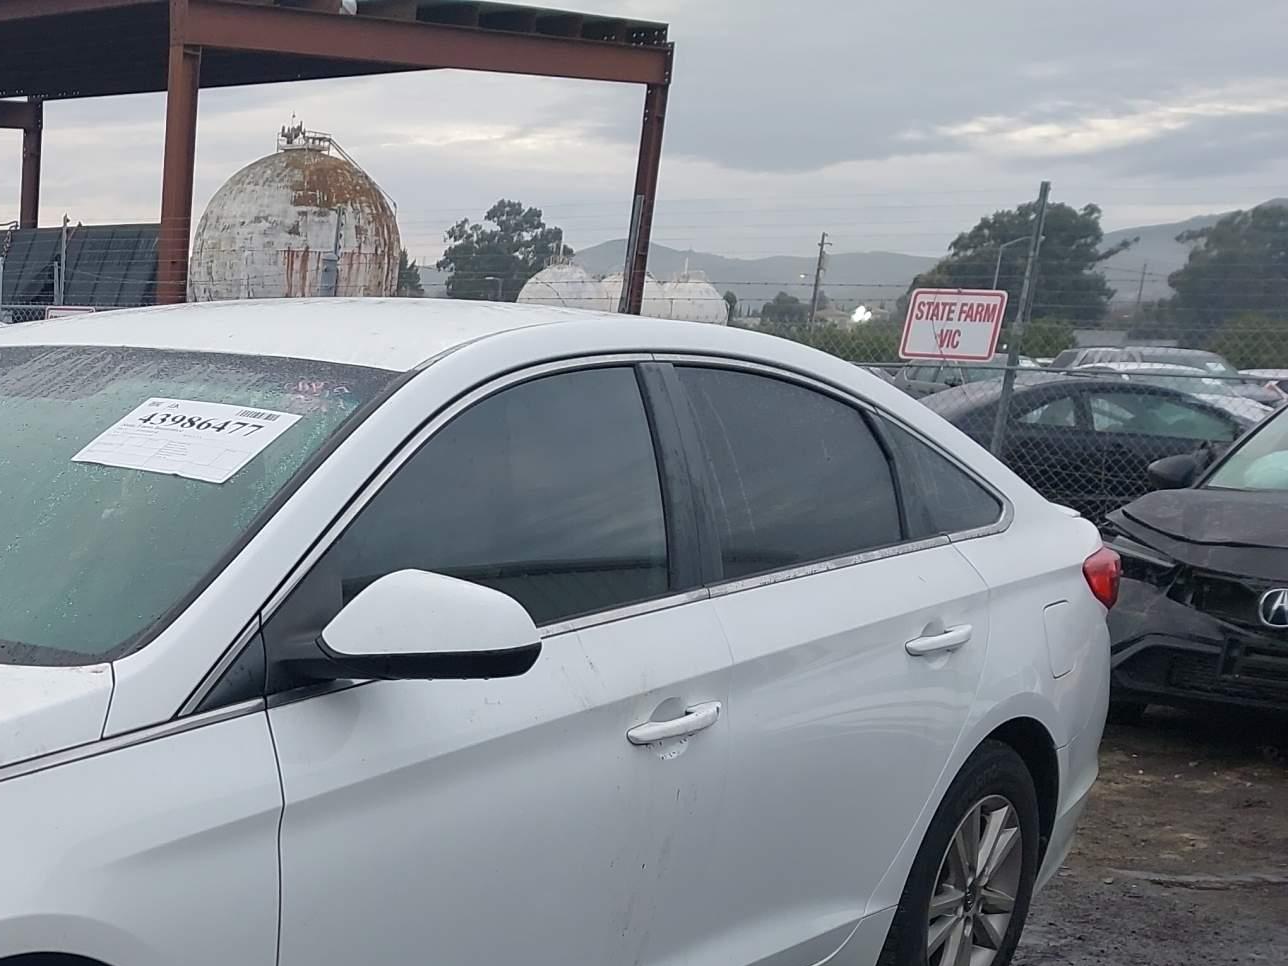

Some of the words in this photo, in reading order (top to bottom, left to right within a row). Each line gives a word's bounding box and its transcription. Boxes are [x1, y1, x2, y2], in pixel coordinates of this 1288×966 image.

[915, 301, 956, 321] STATE
[958, 302, 997, 323] FARM
[938, 329, 961, 349] VIC
[138, 412, 265, 437] 43986477
